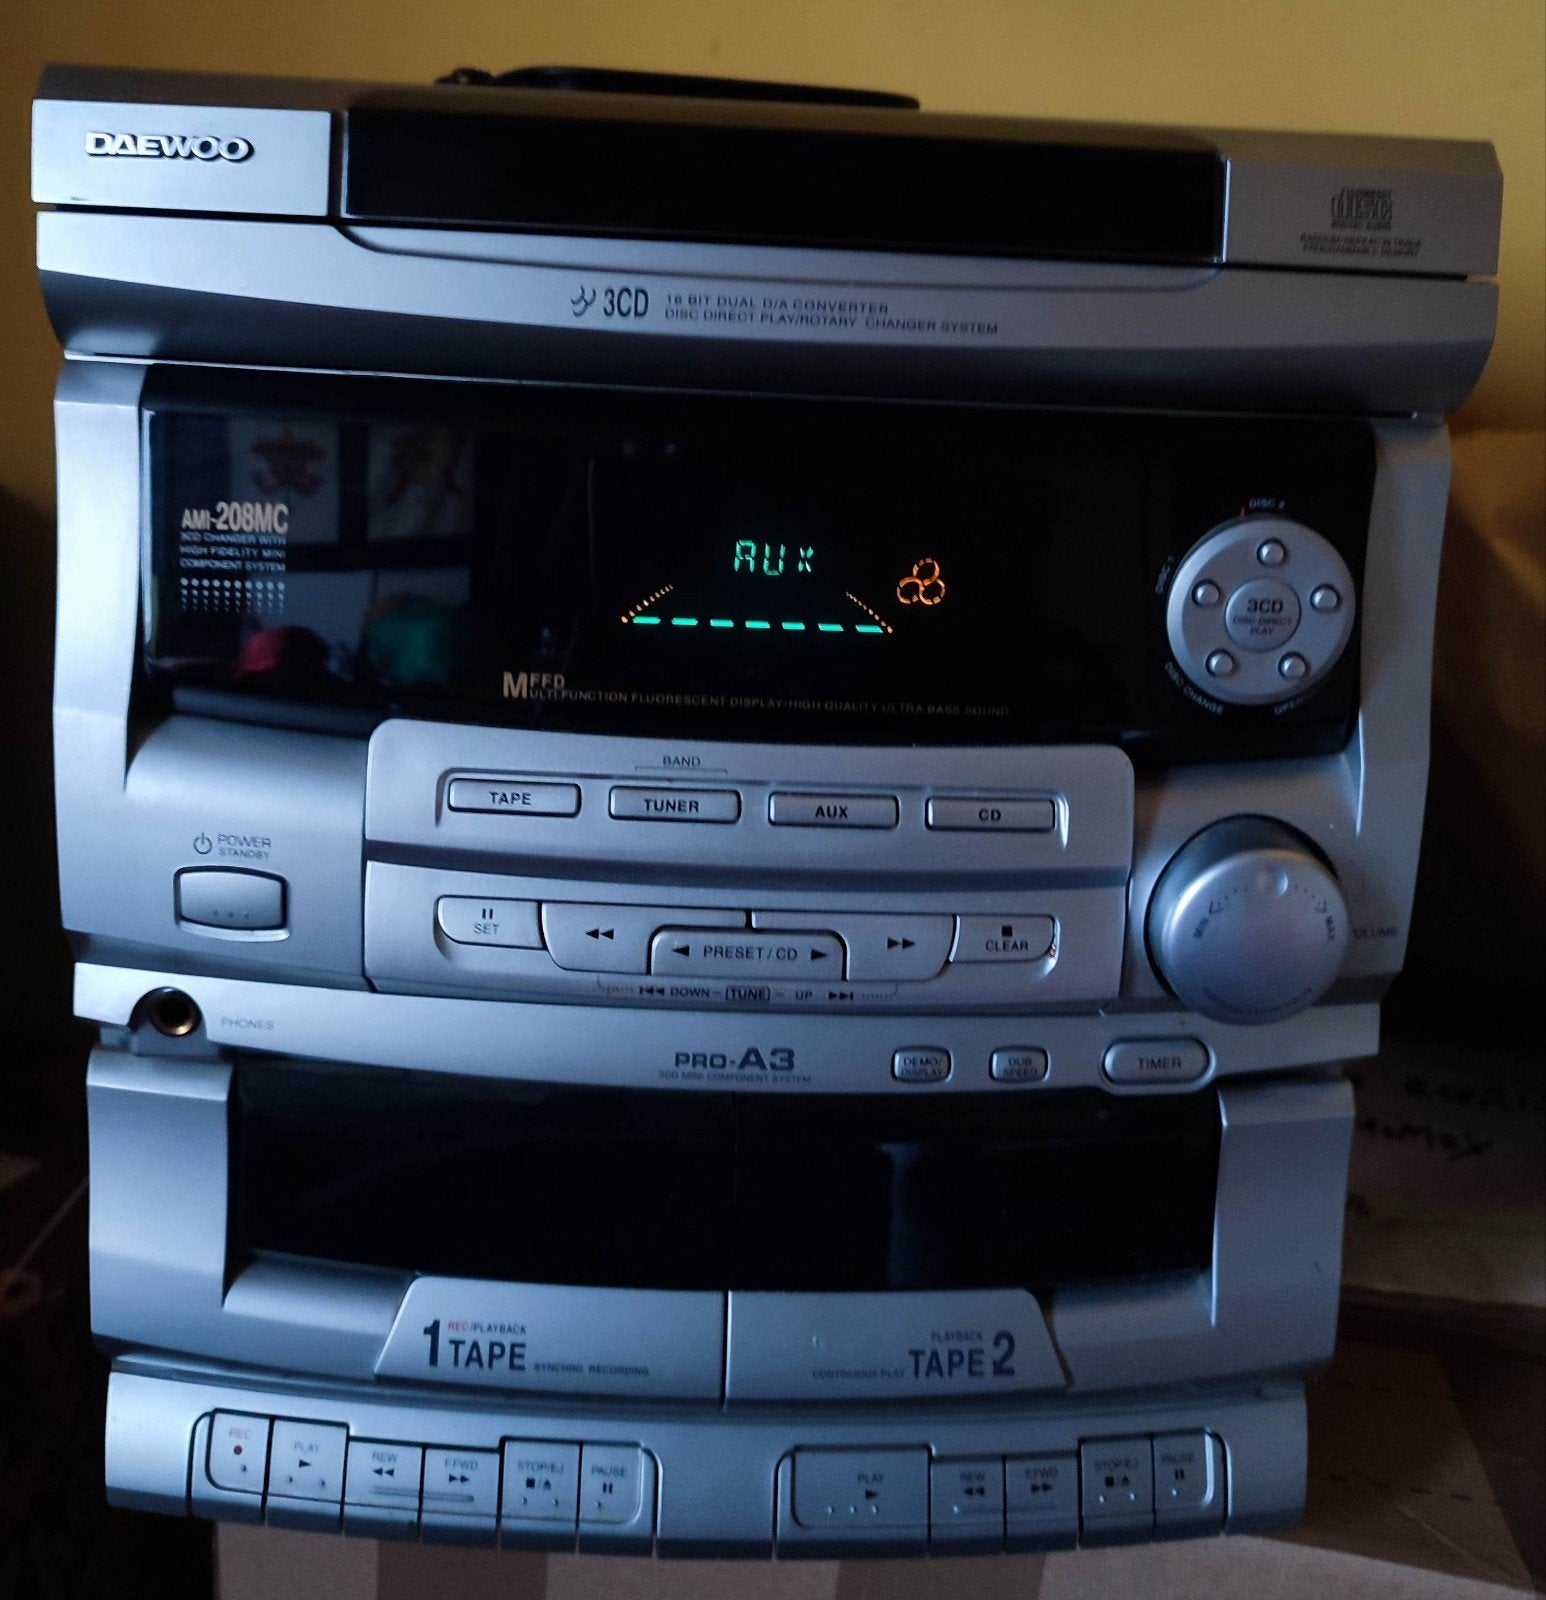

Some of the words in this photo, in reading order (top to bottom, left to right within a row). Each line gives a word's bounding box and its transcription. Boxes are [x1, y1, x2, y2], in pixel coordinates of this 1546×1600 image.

[85, 131, 255, 163] DAEWOO
[603, 287, 649, 318] 3CD
[687, 294, 709, 307] BIT
[717, 295, 757, 309] DUAL
[763, 297, 788, 310] D/A
[793, 299, 889, 314] CONVERTER
[665, 308, 699, 320] DISC
[703, 309, 754, 323] DIRECT
[865, 317, 936, 332] CHANGER
[940, 319, 998, 334] SYSTEM
[734, 539, 814, 576] AUX
[1246, 599, 1284, 615] 3CD
[630, 692, 726, 707] FLUORESCENT
[824, 700, 879, 713] QUALITY
[881, 703, 924, 716] ULTRA
[926, 705, 961, 718] BASS
[964, 706, 1010, 719] SOUND
[662, 754, 701, 768] BAND
[488, 790, 532, 806] TAPE
[643, 798, 700, 815] TUNER
[814, 804, 849, 820] AUX
[978, 808, 1002, 823] CD
[217, 833, 272, 849] POWER
[218, 847, 270, 860] STANDBY
[473, 921, 501, 936] SET
[985, 938, 1029, 953] CLEAR
[670, 986, 711, 998] DOWN
[731, 986, 768, 1001] TUNE
[795, 990, 814, 1001] UP
[220, 1017, 275, 1032] PHONES
[1137, 1056, 1184, 1070] TIMER
[706, 1071, 769, 1084] COMPONENT
[771, 1073, 813, 1085] SYSTEM
[422, 1319, 441, 1368] 1
[931, 1330, 983, 1343] PLAYBACK
[449, 1339, 528, 1371] TAPE
[992, 1329, 1016, 1376] 2
[587, 1364, 650, 1377] RECORDING
[908, 1349, 986, 1378] TAPE
[294, 1441, 319, 1453] PLAY
[372, 1451, 398, 1463] REW
[591, 1464, 628, 1478] PAUSE
[857, 1472, 884, 1483] PLAY
